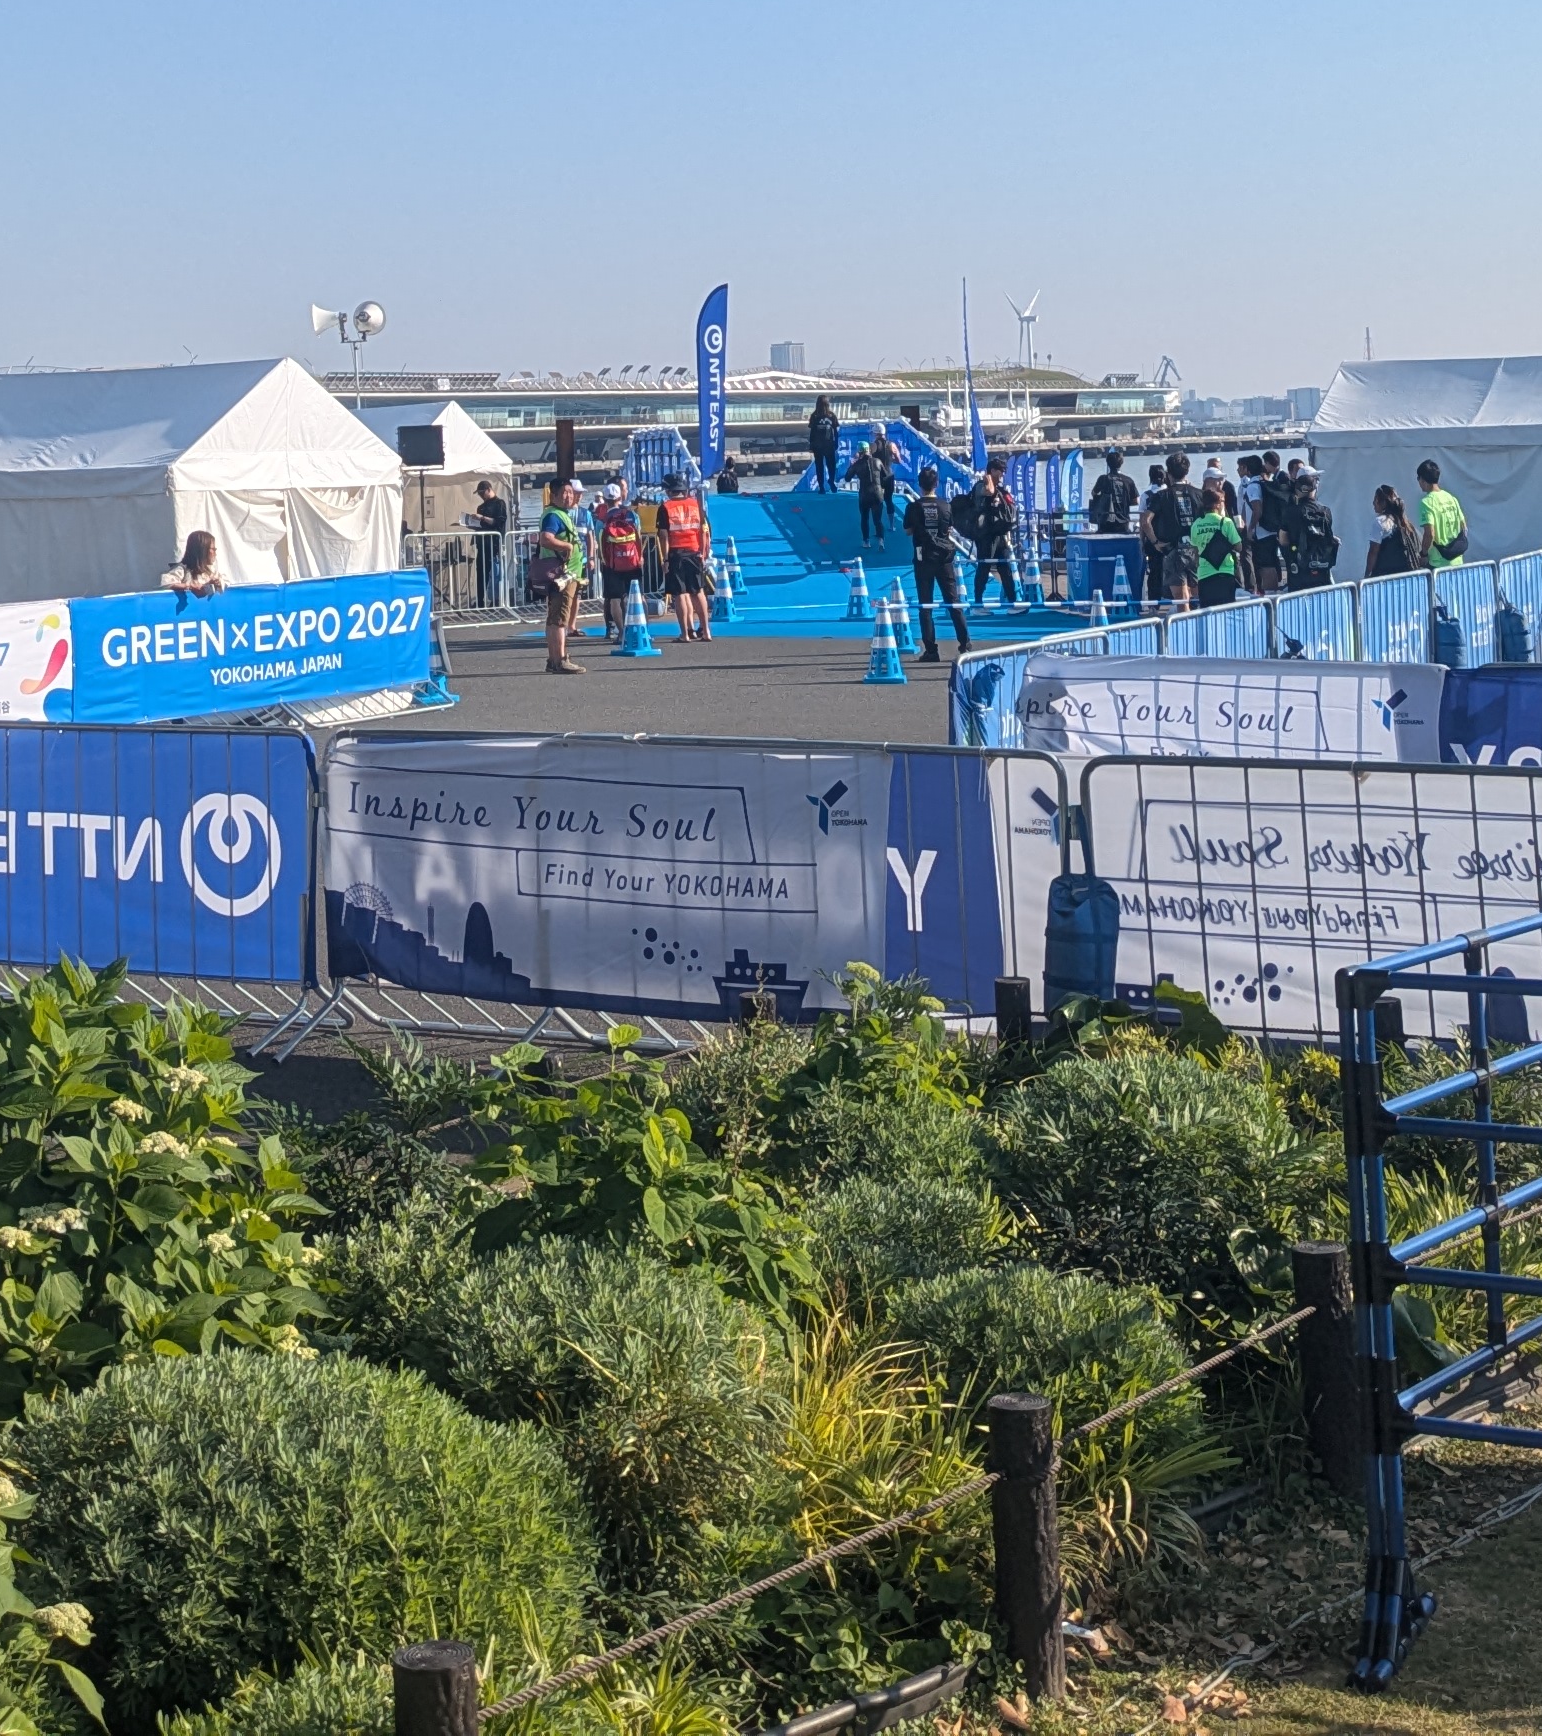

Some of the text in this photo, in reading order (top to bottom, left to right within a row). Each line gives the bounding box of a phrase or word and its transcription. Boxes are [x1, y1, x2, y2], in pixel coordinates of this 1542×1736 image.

[708, 358, 720, 451] NTT EAST
[347, 595, 426, 641] 2027
[210, 652, 342, 686] YOKOHAMA JAPAN
[1117, 692, 1196, 728] Your
[1215, 698, 1295, 733] Soul
[348, 781, 717, 843] Inspire Your Soul
[545, 863, 790, 901] Find Your YOKOHAMA
